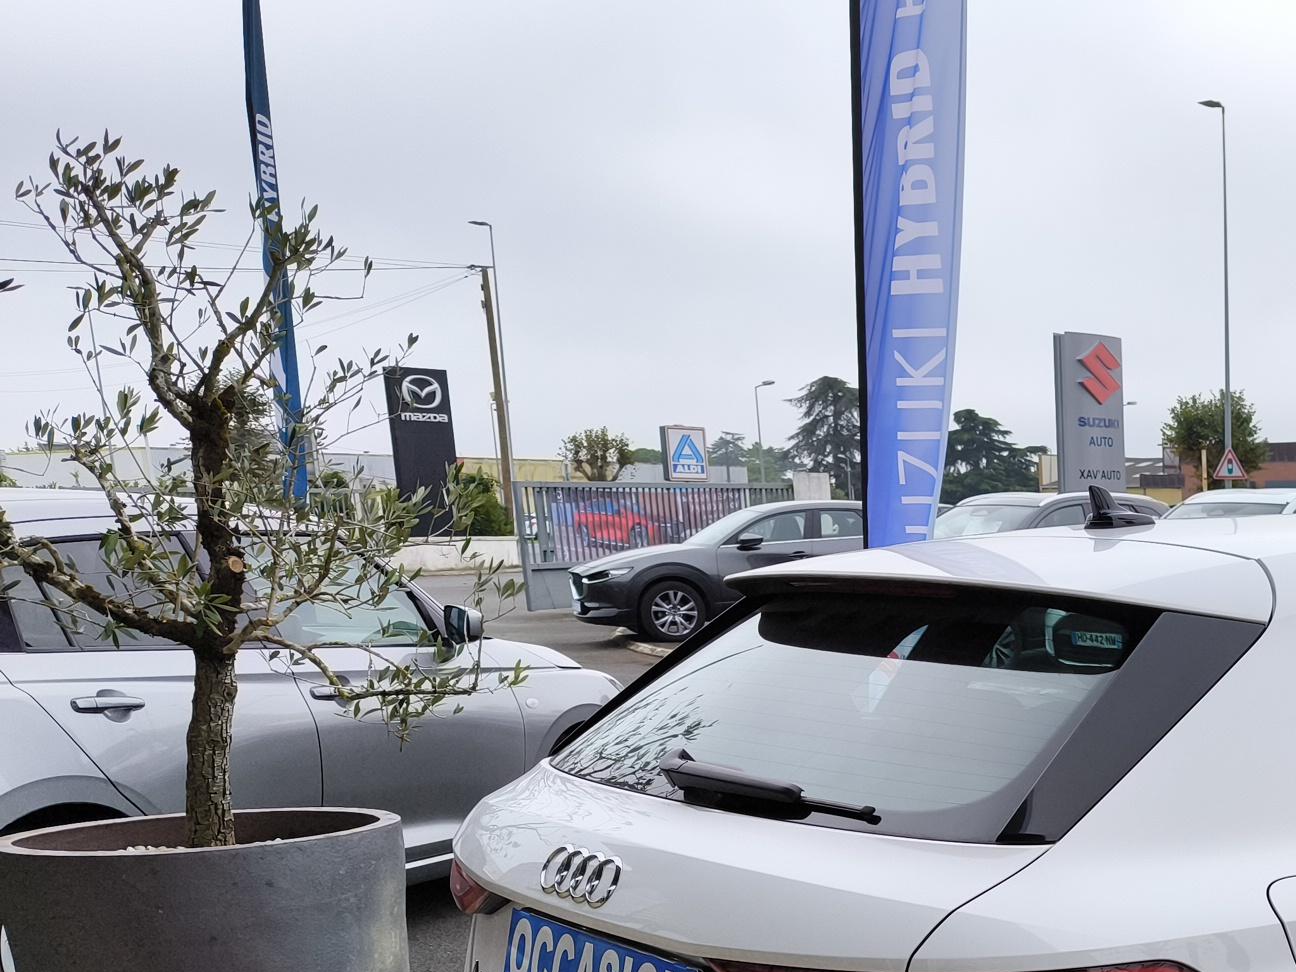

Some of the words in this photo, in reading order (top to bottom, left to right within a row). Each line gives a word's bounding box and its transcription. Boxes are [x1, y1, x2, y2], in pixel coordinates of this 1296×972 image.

[890, 49, 944, 295] HYBRID
[401, 412, 448, 422] mazda
[1078, 416, 1120, 429] SUZUKI
[1089, 436, 1114, 447] AUTO
[675, 463, 702, 473] ALDI
